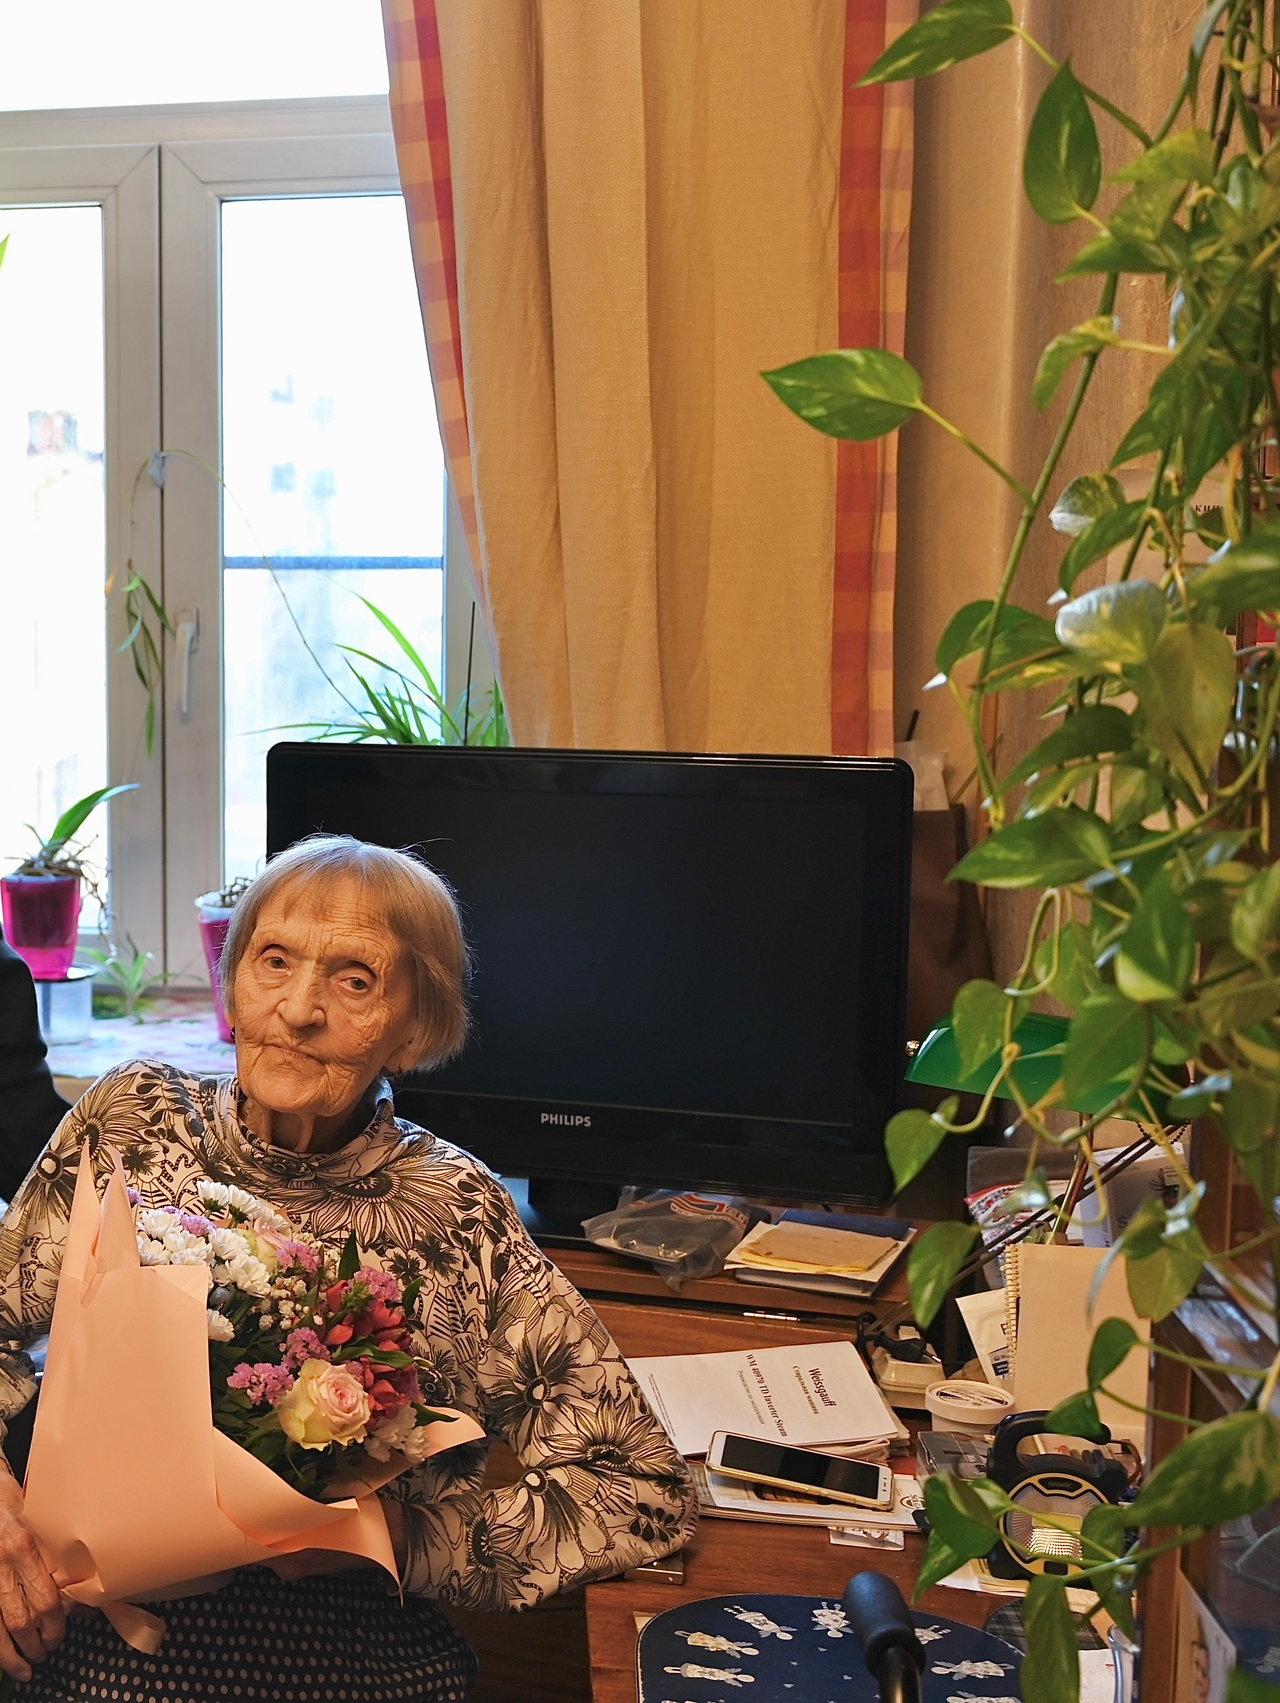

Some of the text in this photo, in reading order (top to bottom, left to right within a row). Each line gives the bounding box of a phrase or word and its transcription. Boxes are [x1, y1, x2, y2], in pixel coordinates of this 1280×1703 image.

[540, 1112, 592, 1128] PHILIPS
[746, 1354, 758, 1367] WM
[759, 1385, 770, 1395] TD
[792, 1365, 819, 1415] Стиральная машина
[808, 1367, 837, 1407] Weissgauff
[763, 1395, 780, 1419] Inverter
[774, 1419, 788, 1438] Steam
